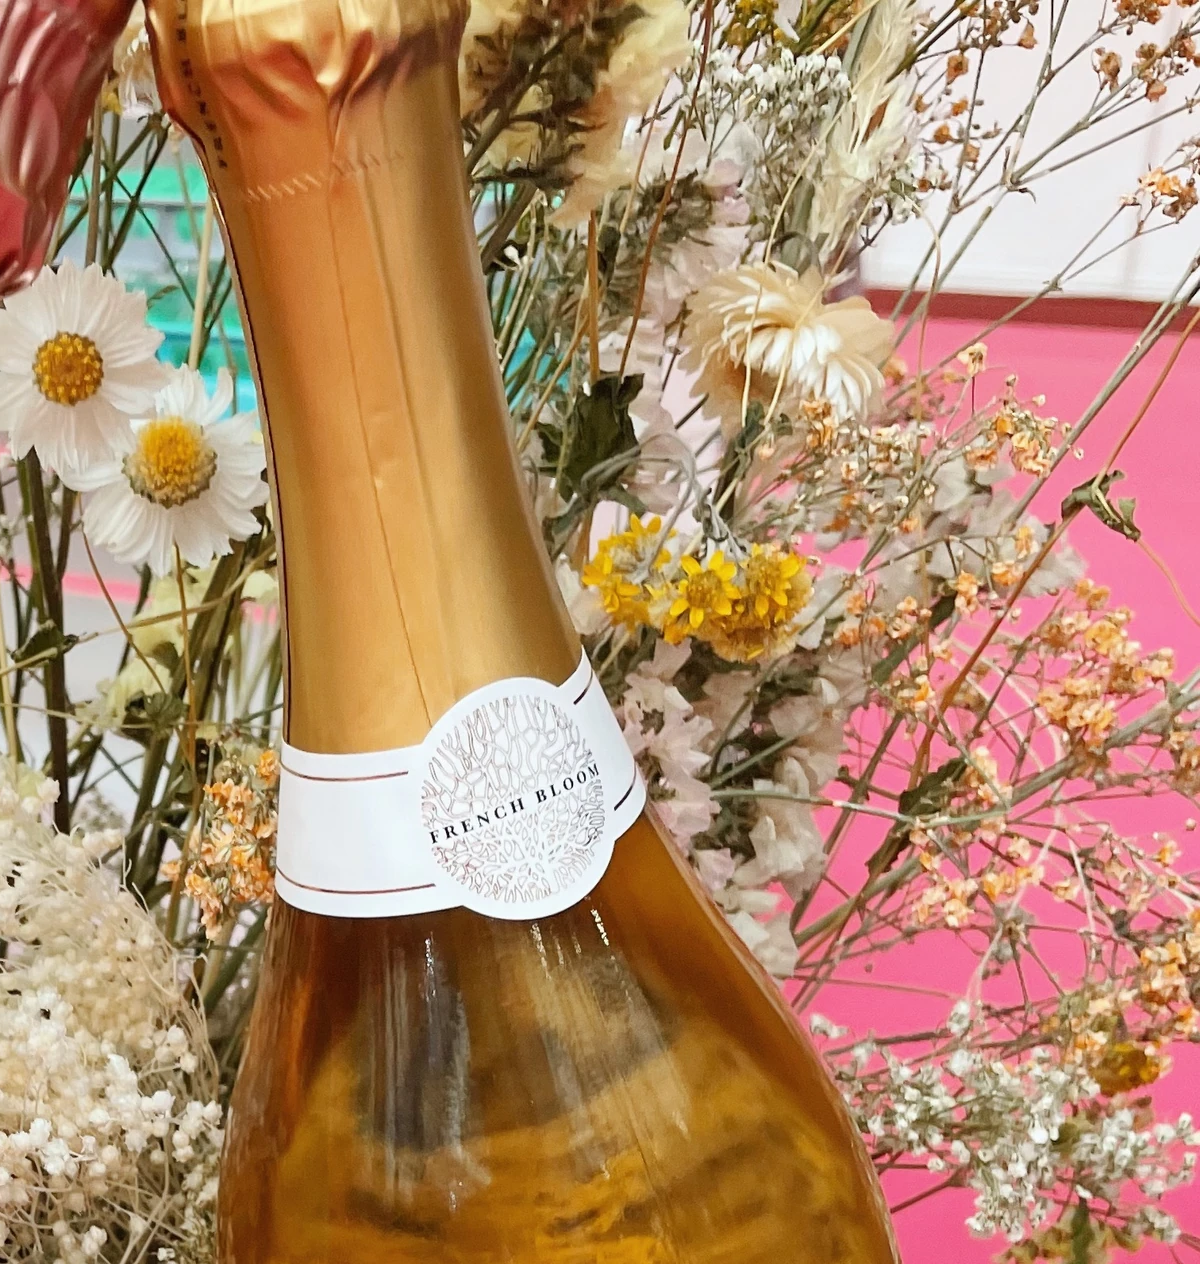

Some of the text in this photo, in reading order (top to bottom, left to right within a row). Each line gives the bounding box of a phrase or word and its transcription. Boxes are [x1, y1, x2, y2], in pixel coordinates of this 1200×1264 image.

[176, 0, 188, 42] BL
[429, 763, 600, 844] FRENCH BLOOM
